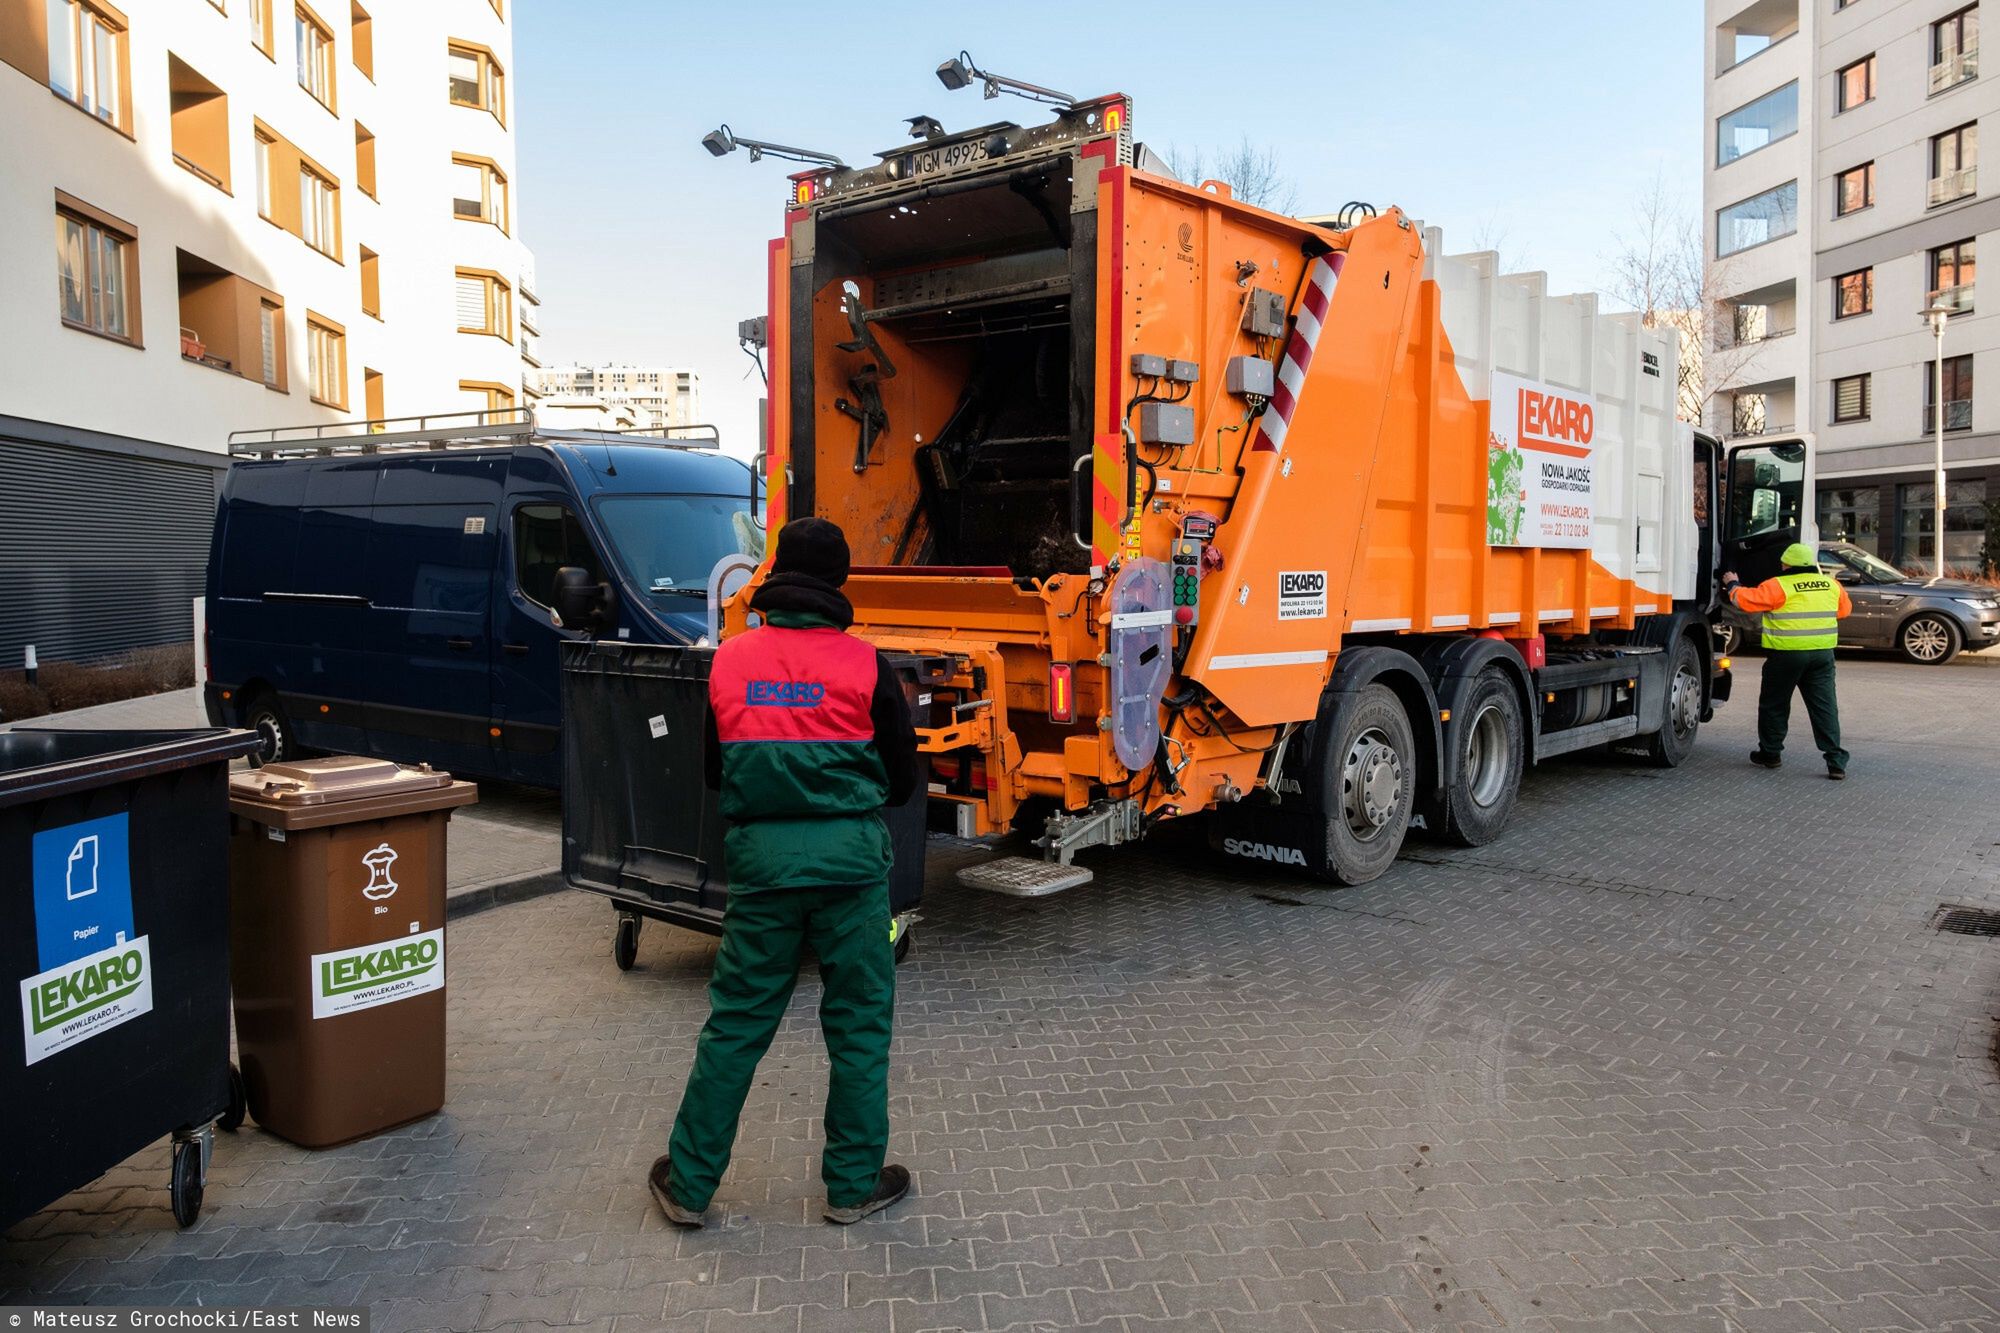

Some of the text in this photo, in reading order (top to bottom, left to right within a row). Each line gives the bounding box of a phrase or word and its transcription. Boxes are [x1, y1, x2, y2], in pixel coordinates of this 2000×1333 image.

[914, 140, 987, 174] WGM 49925
[1518, 388, 1593, 458] LEKARO
[1542, 463, 1591, 483] NOWA JAKOŚĆ
[1541, 504, 1589, 519] WWW.LEKARO.PL
[1555, 523, 1561, 536] 22
[1281, 573, 1324, 598] LEKARO
[1793, 580, 1830, 593] LEKARO
[1281, 607, 1323, 616] www.lekaro.pl
[747, 681, 824, 707] LEKARO
[1223, 837, 1308, 867] SCANIA
[374, 905, 389, 915] Bio
[73, 925, 100, 941] Papier
[321, 938, 438, 997] LEKARO
[30, 949, 144, 1035] LEKARO
[352, 980, 415, 1001] WWW.LEKARO.PL
[61, 1003, 122, 1036] WWW.LEKARO.PL
